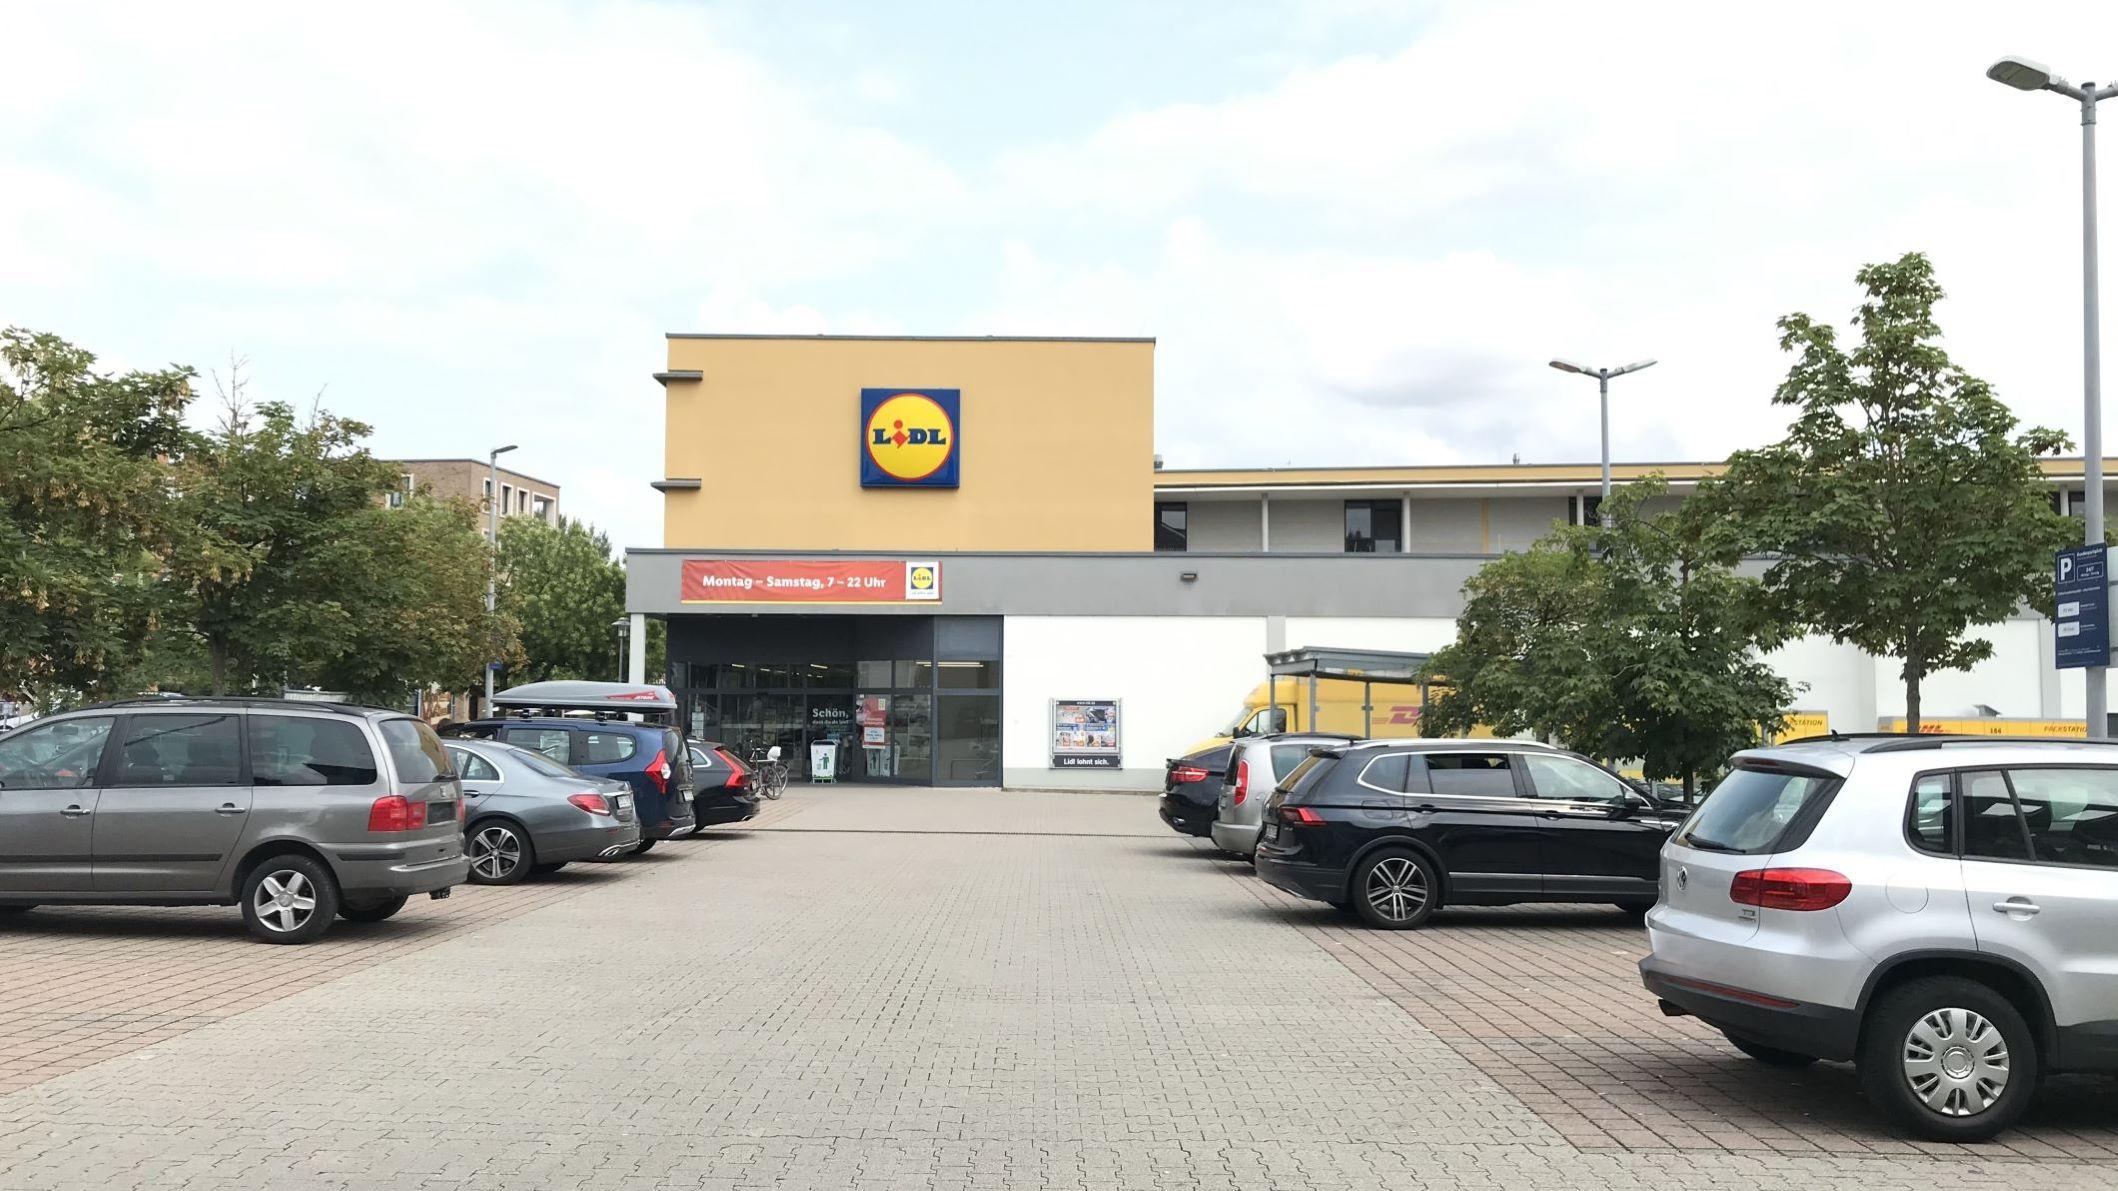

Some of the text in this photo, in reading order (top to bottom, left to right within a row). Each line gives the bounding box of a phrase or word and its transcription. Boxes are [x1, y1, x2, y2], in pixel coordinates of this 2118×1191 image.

[2060, 557, 2072, 581] P
[702, 575, 753, 590] Montag
[766, 576, 825, 590] Samstag,
[827, 576, 835, 588] 7
[847, 576, 861, 588] 22
[864, 576, 887, 588] Uhr
[812, 707, 849, 719] Schön,
